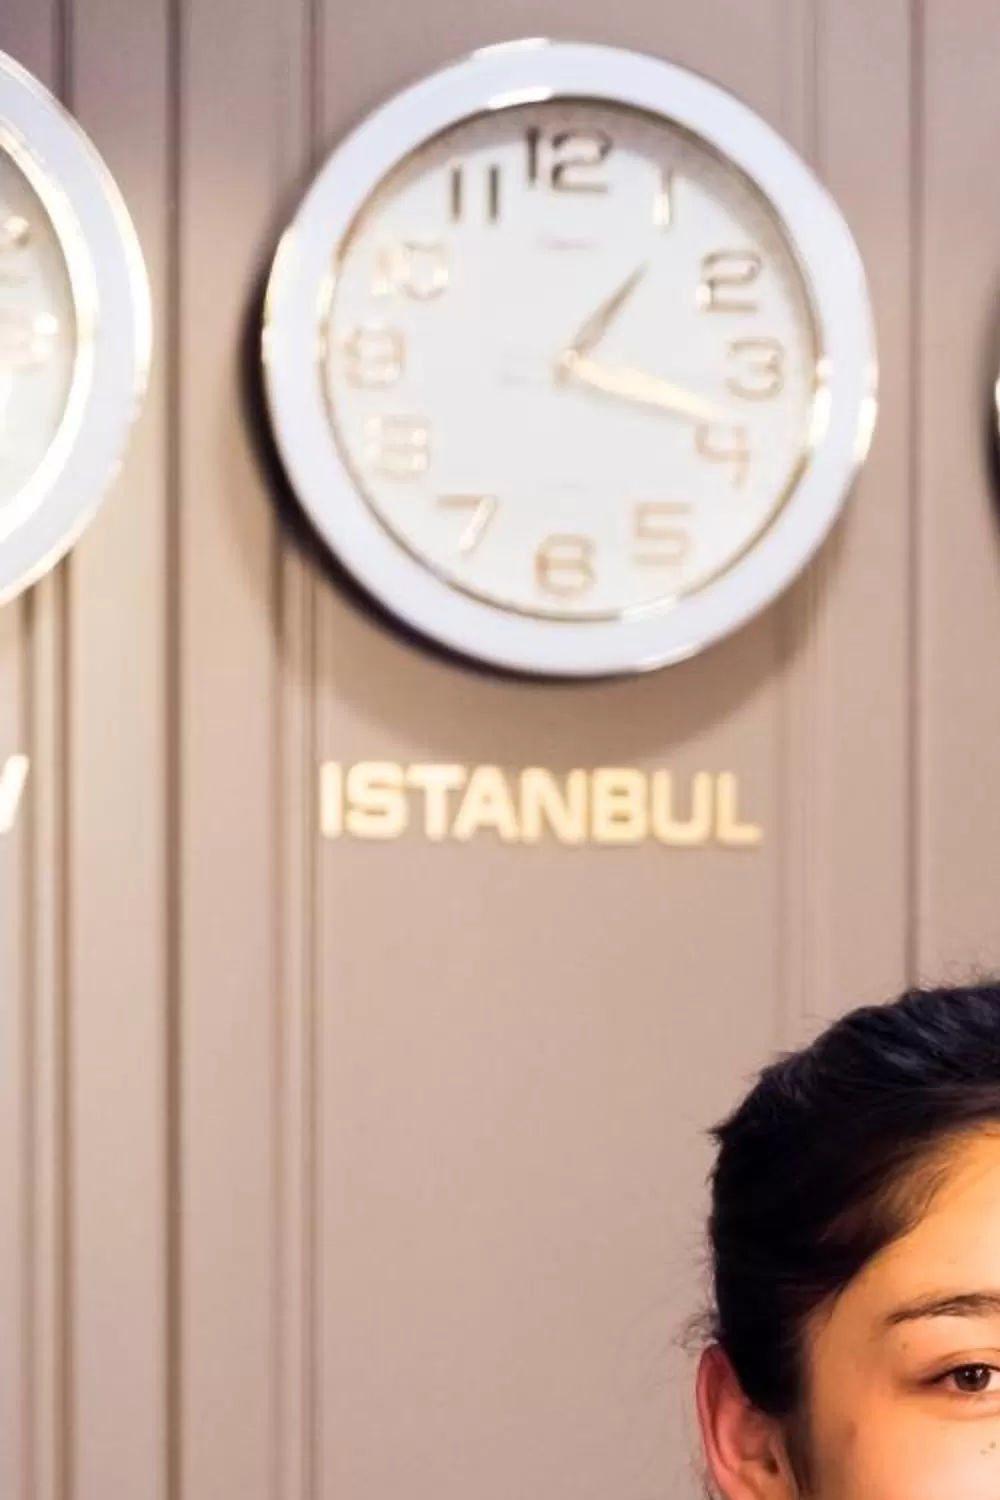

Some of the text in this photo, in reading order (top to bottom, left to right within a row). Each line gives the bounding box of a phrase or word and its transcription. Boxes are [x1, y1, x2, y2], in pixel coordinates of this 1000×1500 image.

[524, 126, 614, 194] 12
[448, 164, 503, 226] 11
[652, 167, 676, 230] 1
[696, 247, 763, 313] 2
[726, 335, 785, 401] 3
[694, 418, 753, 490] 4
[433, 494, 501, 555] 7
[632, 500, 693, 567] 5
[533, 533, 597, 598] 6
[319, 759, 764, 848] ISTANBUL
